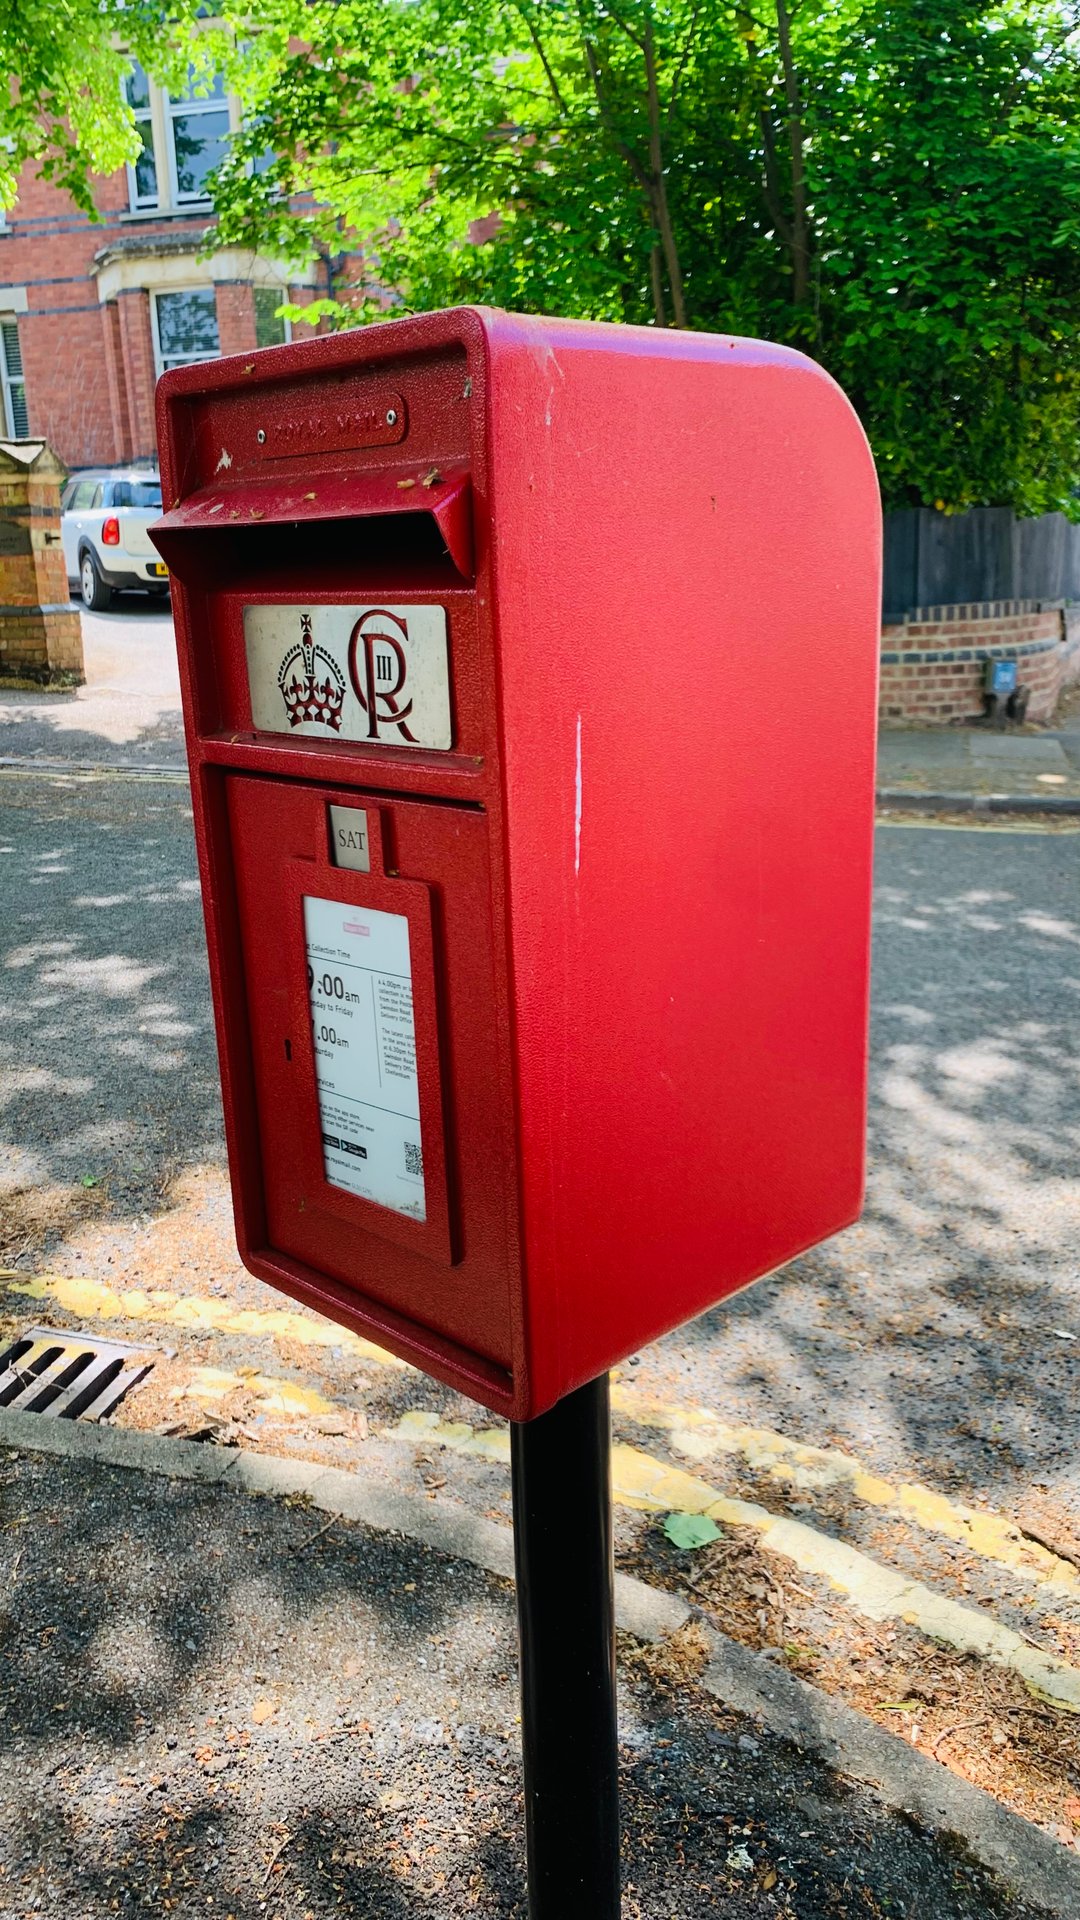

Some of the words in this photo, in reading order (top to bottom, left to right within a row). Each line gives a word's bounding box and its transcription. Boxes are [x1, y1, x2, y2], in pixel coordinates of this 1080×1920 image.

[338, 828, 366, 850] SAT
[312, 943, 337, 956] Collection
[337, 949, 351, 959] Time
[327, 1003, 333, 1011] to
[335, 1004, 353, 1018] Friday
[312, 1019, 350, 1048] .00am
